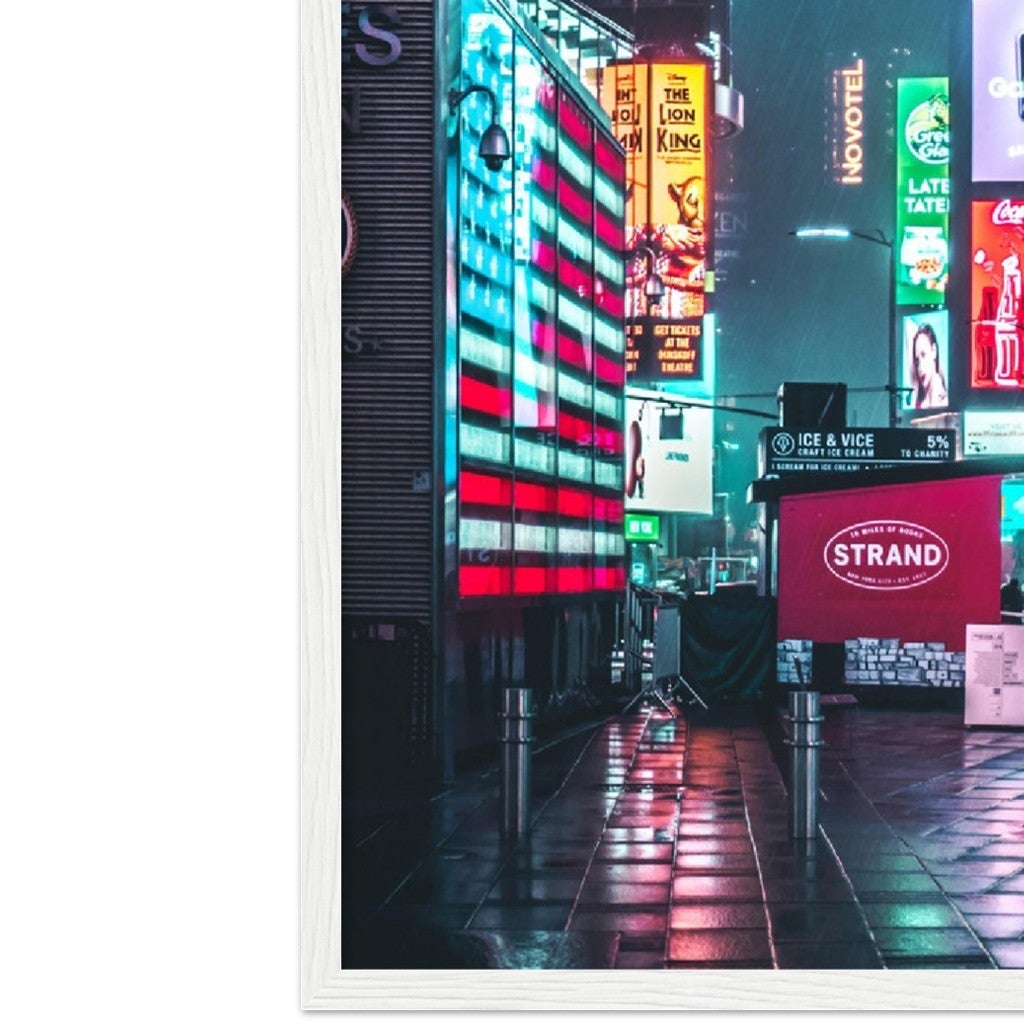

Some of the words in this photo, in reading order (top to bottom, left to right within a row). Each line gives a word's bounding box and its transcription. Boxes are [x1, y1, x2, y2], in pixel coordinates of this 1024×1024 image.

[664, 88, 690, 100] THE
[842, 58, 863, 185] NOVOTEL
[903, 197, 950, 213] TATE
[653, 325, 669, 336] GET
[671, 325, 701, 336] TICKETS
[664, 337, 675, 348] AT
[676, 337, 690, 348] THE
[798, 432, 821, 447] ICE
[826, 432, 837, 447] &
[841, 433, 874, 447] VICE
[927, 435, 950, 449] 5%
[797, 448, 825, 457] CRAFT
[827, 448, 841, 457] ICE
[844, 448, 875, 457] CREAM
[900, 448, 911, 458] TO
[914, 450, 950, 458] CHARITY
[806, 463, 819, 471] FOR
[834, 543, 942, 566] STRAND
